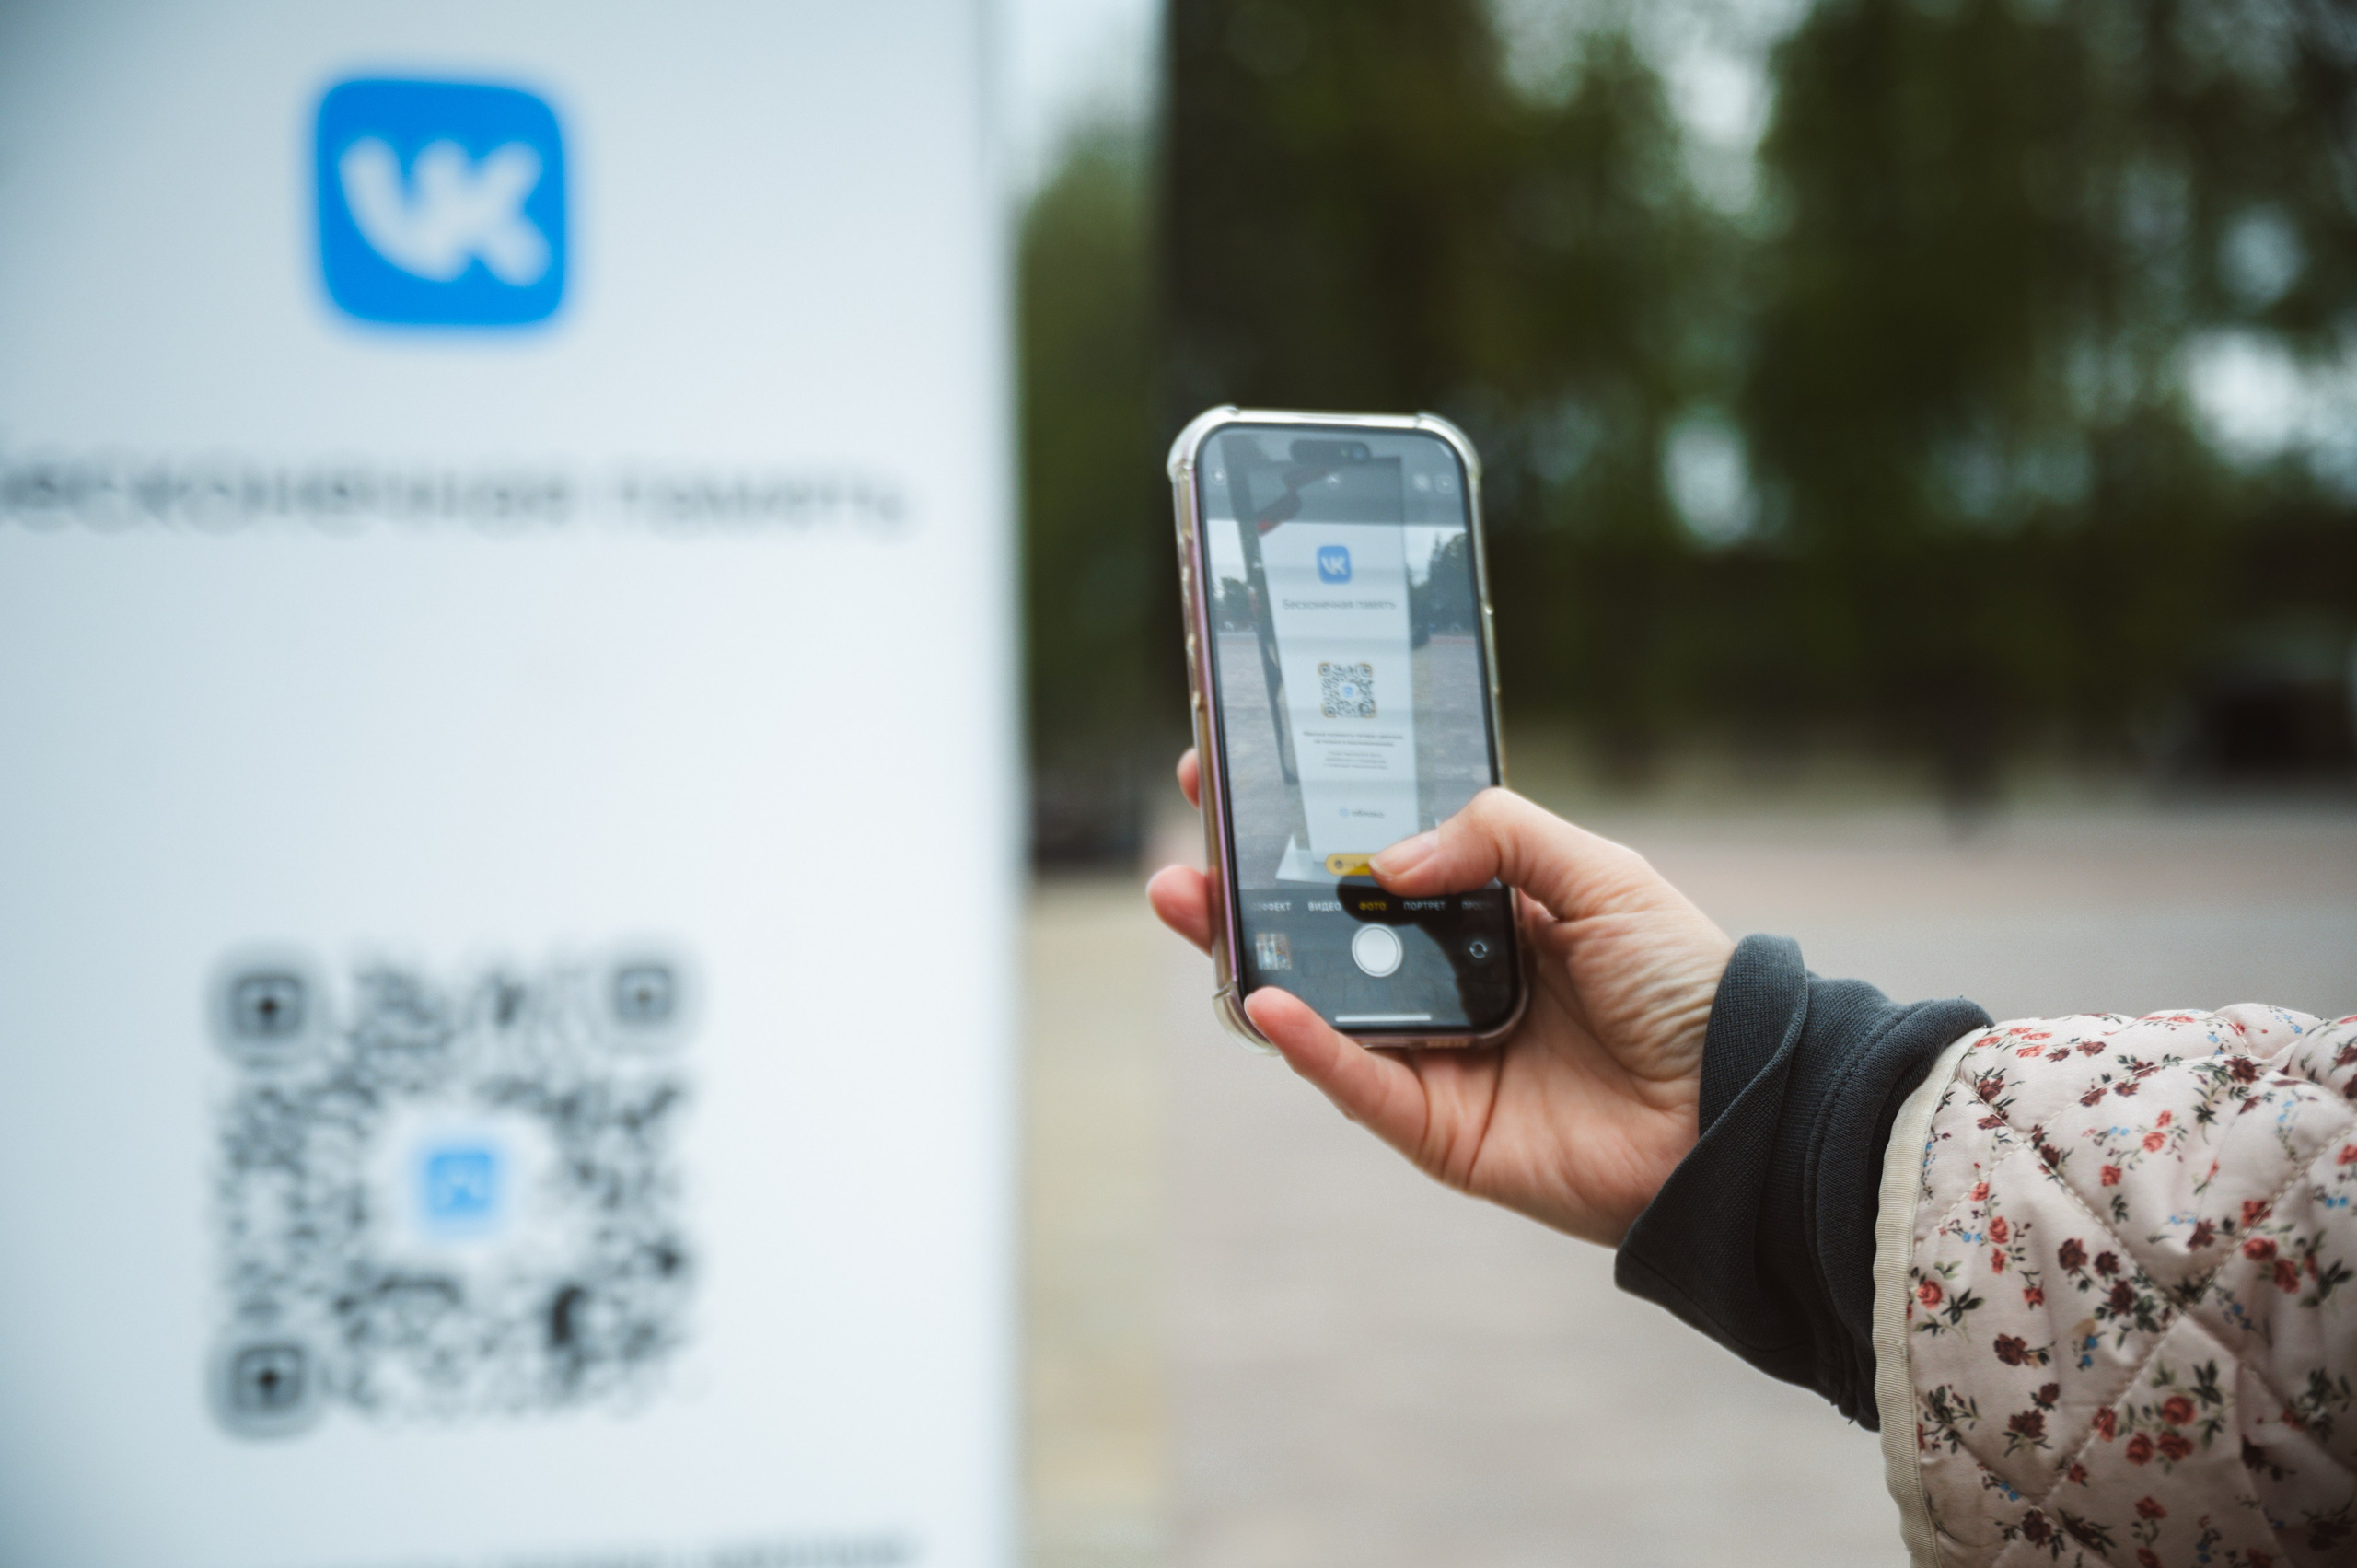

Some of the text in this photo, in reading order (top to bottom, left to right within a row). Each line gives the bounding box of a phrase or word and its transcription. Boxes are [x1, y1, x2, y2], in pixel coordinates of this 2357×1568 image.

[333, 134, 552, 289] VK
[1307, 901, 1341, 912] ВИДЕО
[1358, 901, 1387, 912] ФОТО
[1403, 901, 1446, 912] ПОРТРЕТ
